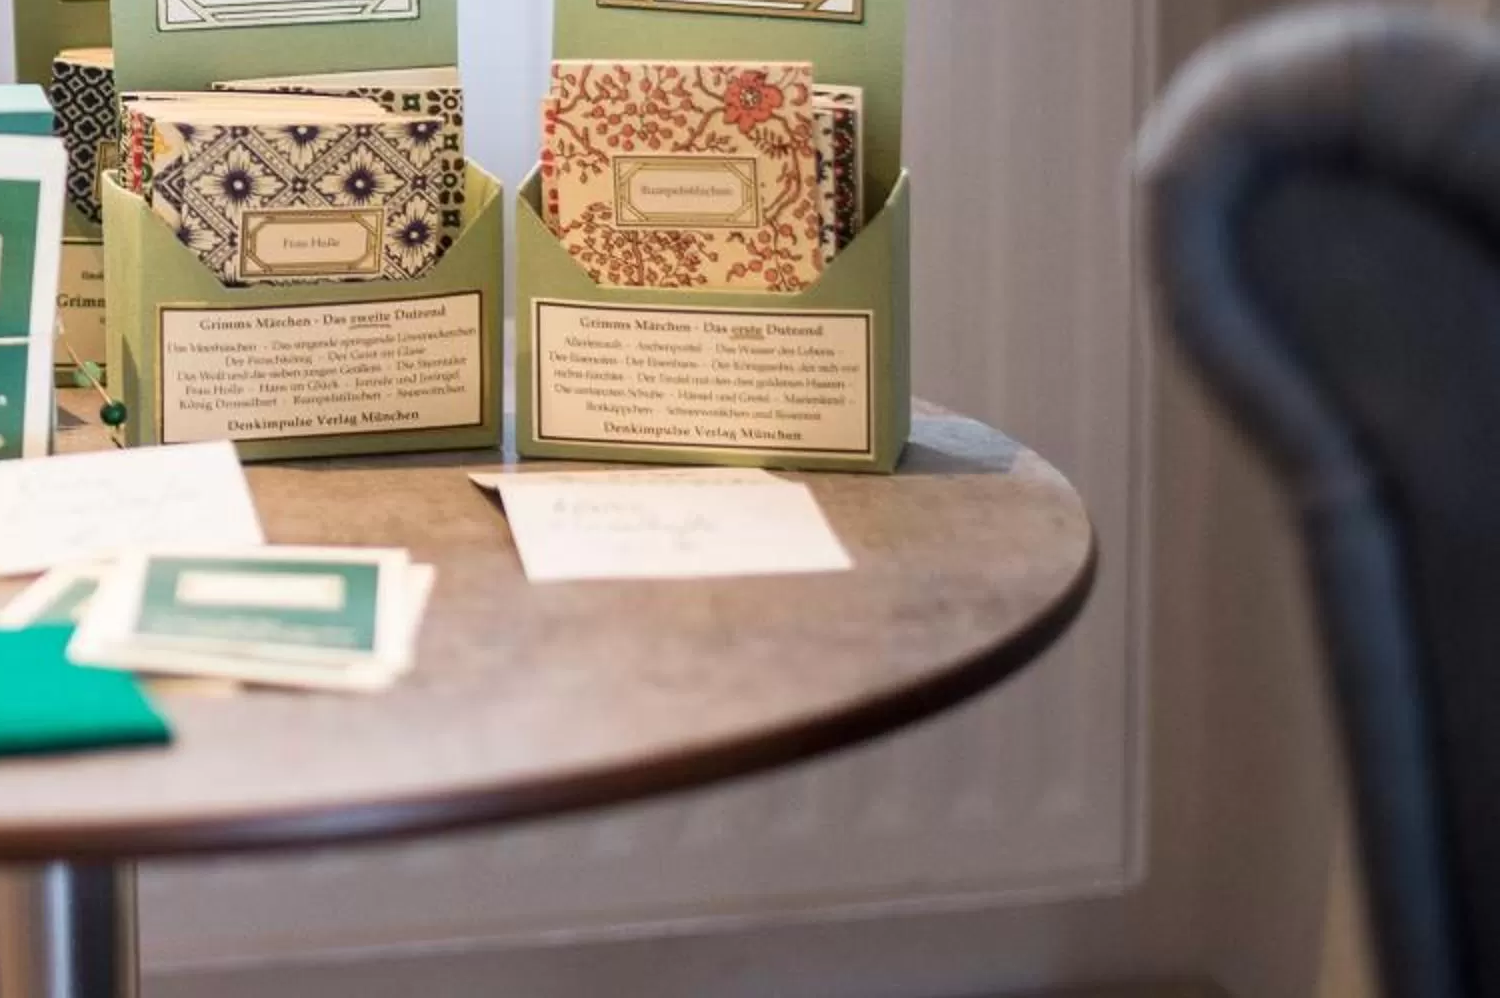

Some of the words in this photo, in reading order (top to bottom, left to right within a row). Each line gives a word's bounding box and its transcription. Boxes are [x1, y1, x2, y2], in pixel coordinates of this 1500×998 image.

[56, 293, 106, 309] Grimm
[200, 318, 252, 331] Grimms
[255, 315, 312, 329] Märchen
[322, 313, 347, 326] Das
[580, 317, 631, 330] Grimms
[634, 319, 692, 332] Märchen
[703, 321, 728, 334] Das
[228, 416, 313, 432] Denkimpulse
[317, 413, 357, 428] Verlag
[360, 409, 420, 424] München
[603, 421, 691, 438] Denkimpulse
[694, 424, 737, 441] Verlag
[740, 426, 802, 441] München
